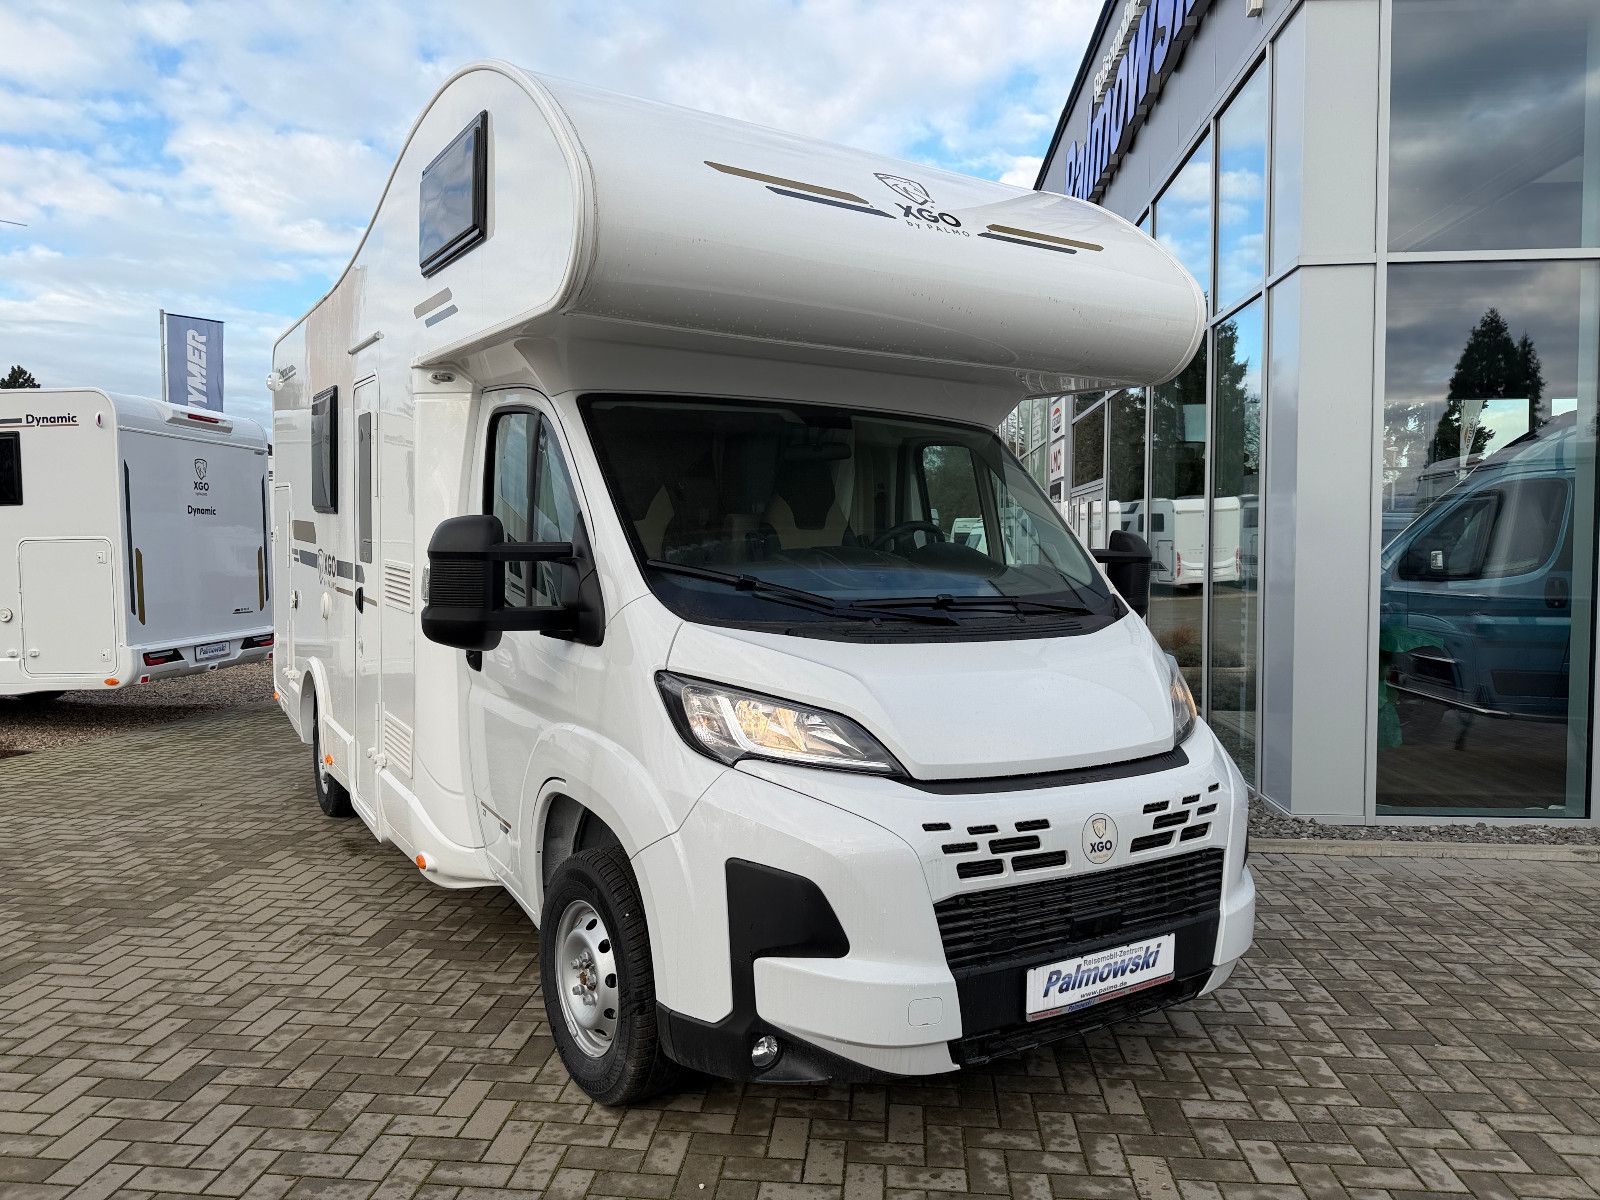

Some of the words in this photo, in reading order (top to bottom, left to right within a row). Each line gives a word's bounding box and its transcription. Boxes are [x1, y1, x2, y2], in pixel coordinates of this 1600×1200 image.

[894, 202, 962, 228] XGO
[927, 223, 970, 238] PALMO
[186, 328, 208, 408] YMER
[25, 412, 78, 427] Dynamic
[193, 480, 210, 492] XGO
[187, 504, 217, 517] Dynamic
[1089, 839, 1113, 854] XGO
[1042, 942, 1162, 999] Palmowski
